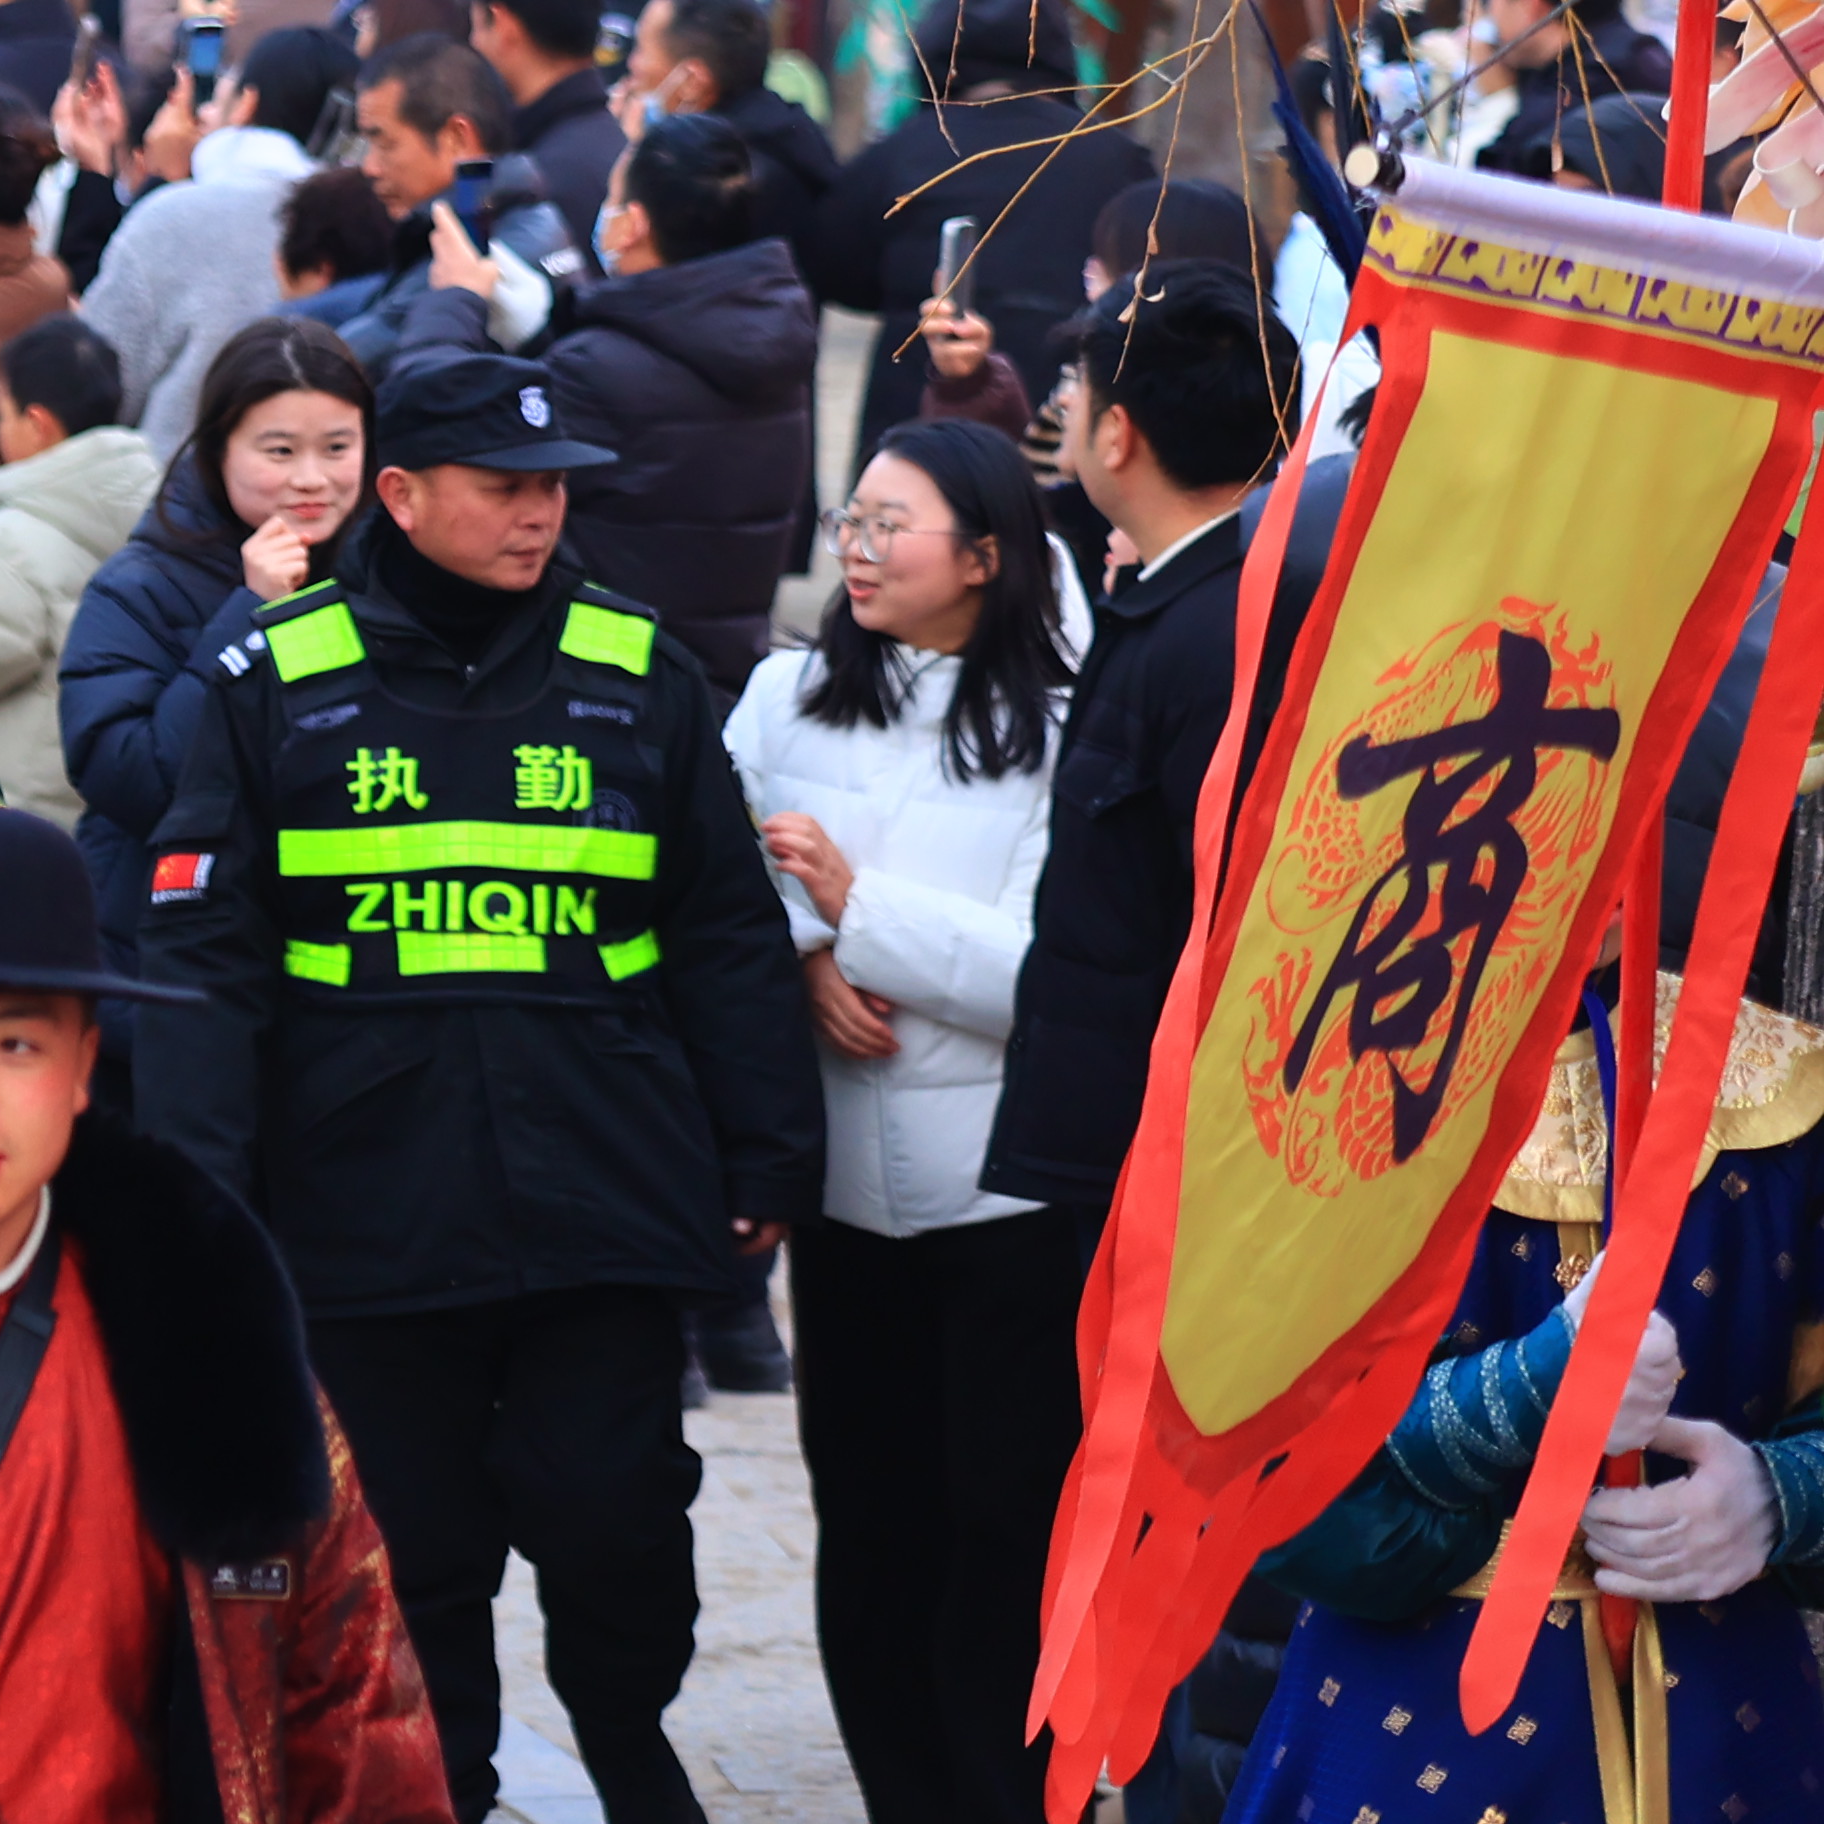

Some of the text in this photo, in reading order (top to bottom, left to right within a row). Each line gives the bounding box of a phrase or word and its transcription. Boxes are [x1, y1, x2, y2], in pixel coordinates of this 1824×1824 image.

[346, 745, 594, 814] 执勤
[345, 880, 599, 936] ZHIQIN
[1283, 629, 1621, 1164] 商
